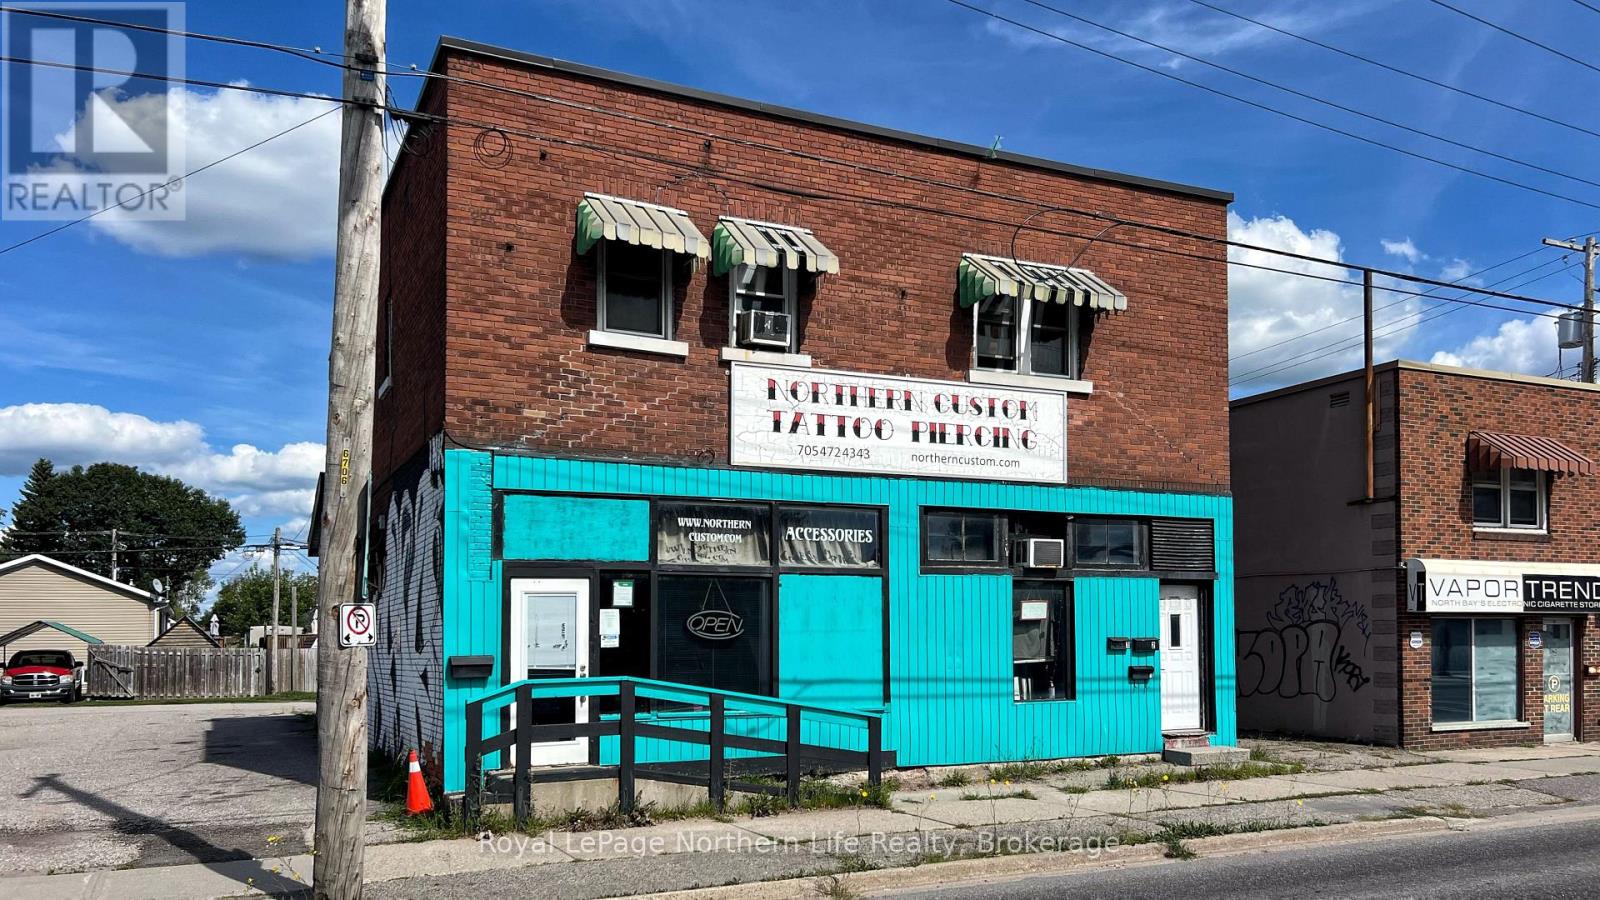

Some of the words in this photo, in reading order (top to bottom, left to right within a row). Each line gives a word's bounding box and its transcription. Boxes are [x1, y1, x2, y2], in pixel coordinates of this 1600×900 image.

[767, 378, 923, 413] NORTHERN
[934, 393, 1038, 421] CUSTOM
[767, 410, 894, 441] TATTOO
[911, 421, 1038, 451] PIERCING
[797, 445, 870, 460] 7054724343
[911, 453, 1021, 468] northerncustom.com
[341, 449, 349, 485] 6706
[678, 517, 752, 530] WWW.NORTHERN
[786, 526, 873, 543] ACCESSORIES
[1430, 578, 1519, 598] VAPOR
[1431, 599, 1460, 607] NORTH
[1488, 600, 1536, 608] ELECTRONIC
[1537, 600, 1578, 608] CIGARETTE
[689, 616, 743, 633] OPEN
[1550, 704, 1570, 713] REAR
